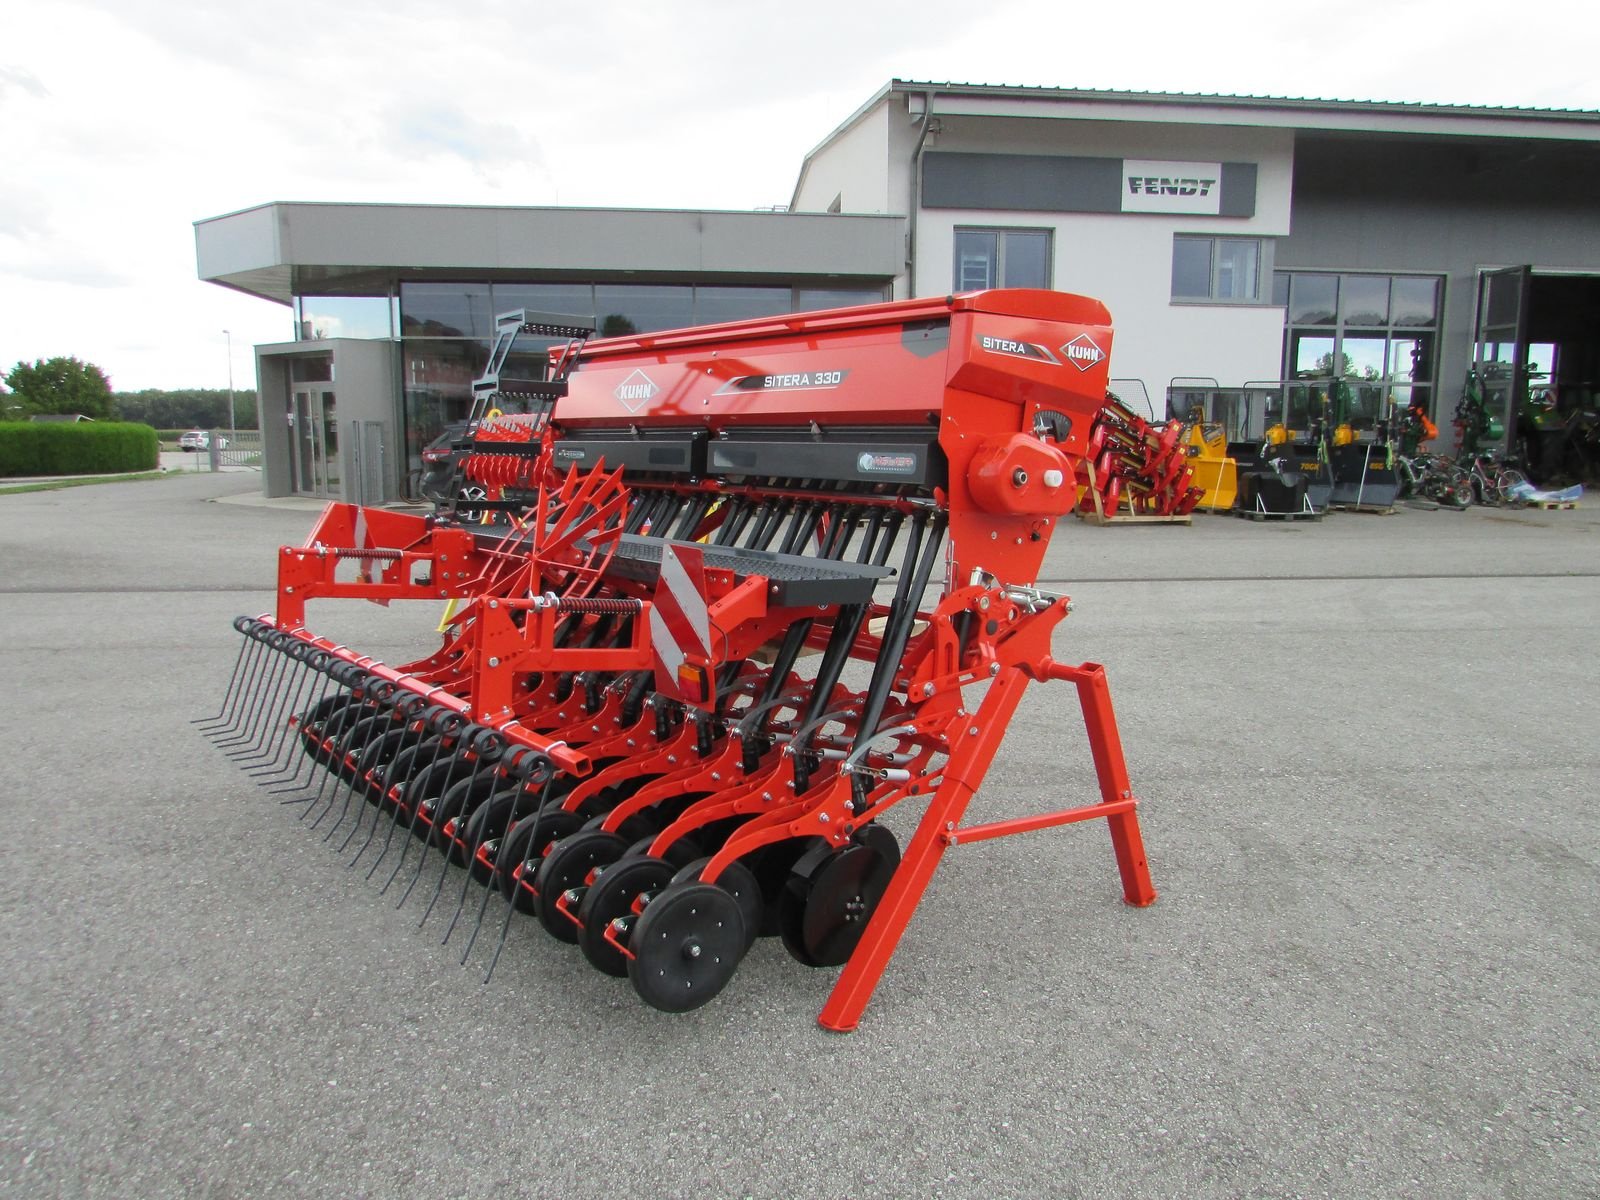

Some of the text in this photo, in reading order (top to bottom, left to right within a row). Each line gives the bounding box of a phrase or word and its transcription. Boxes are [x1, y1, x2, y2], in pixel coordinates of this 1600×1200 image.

[1128, 177, 1216, 196] FENDT
[983, 337, 1026, 354] SITERA
[1067, 344, 1099, 361] KUHN
[764, 371, 841, 388] SITERA 330
[620, 383, 651, 400] KUHN
